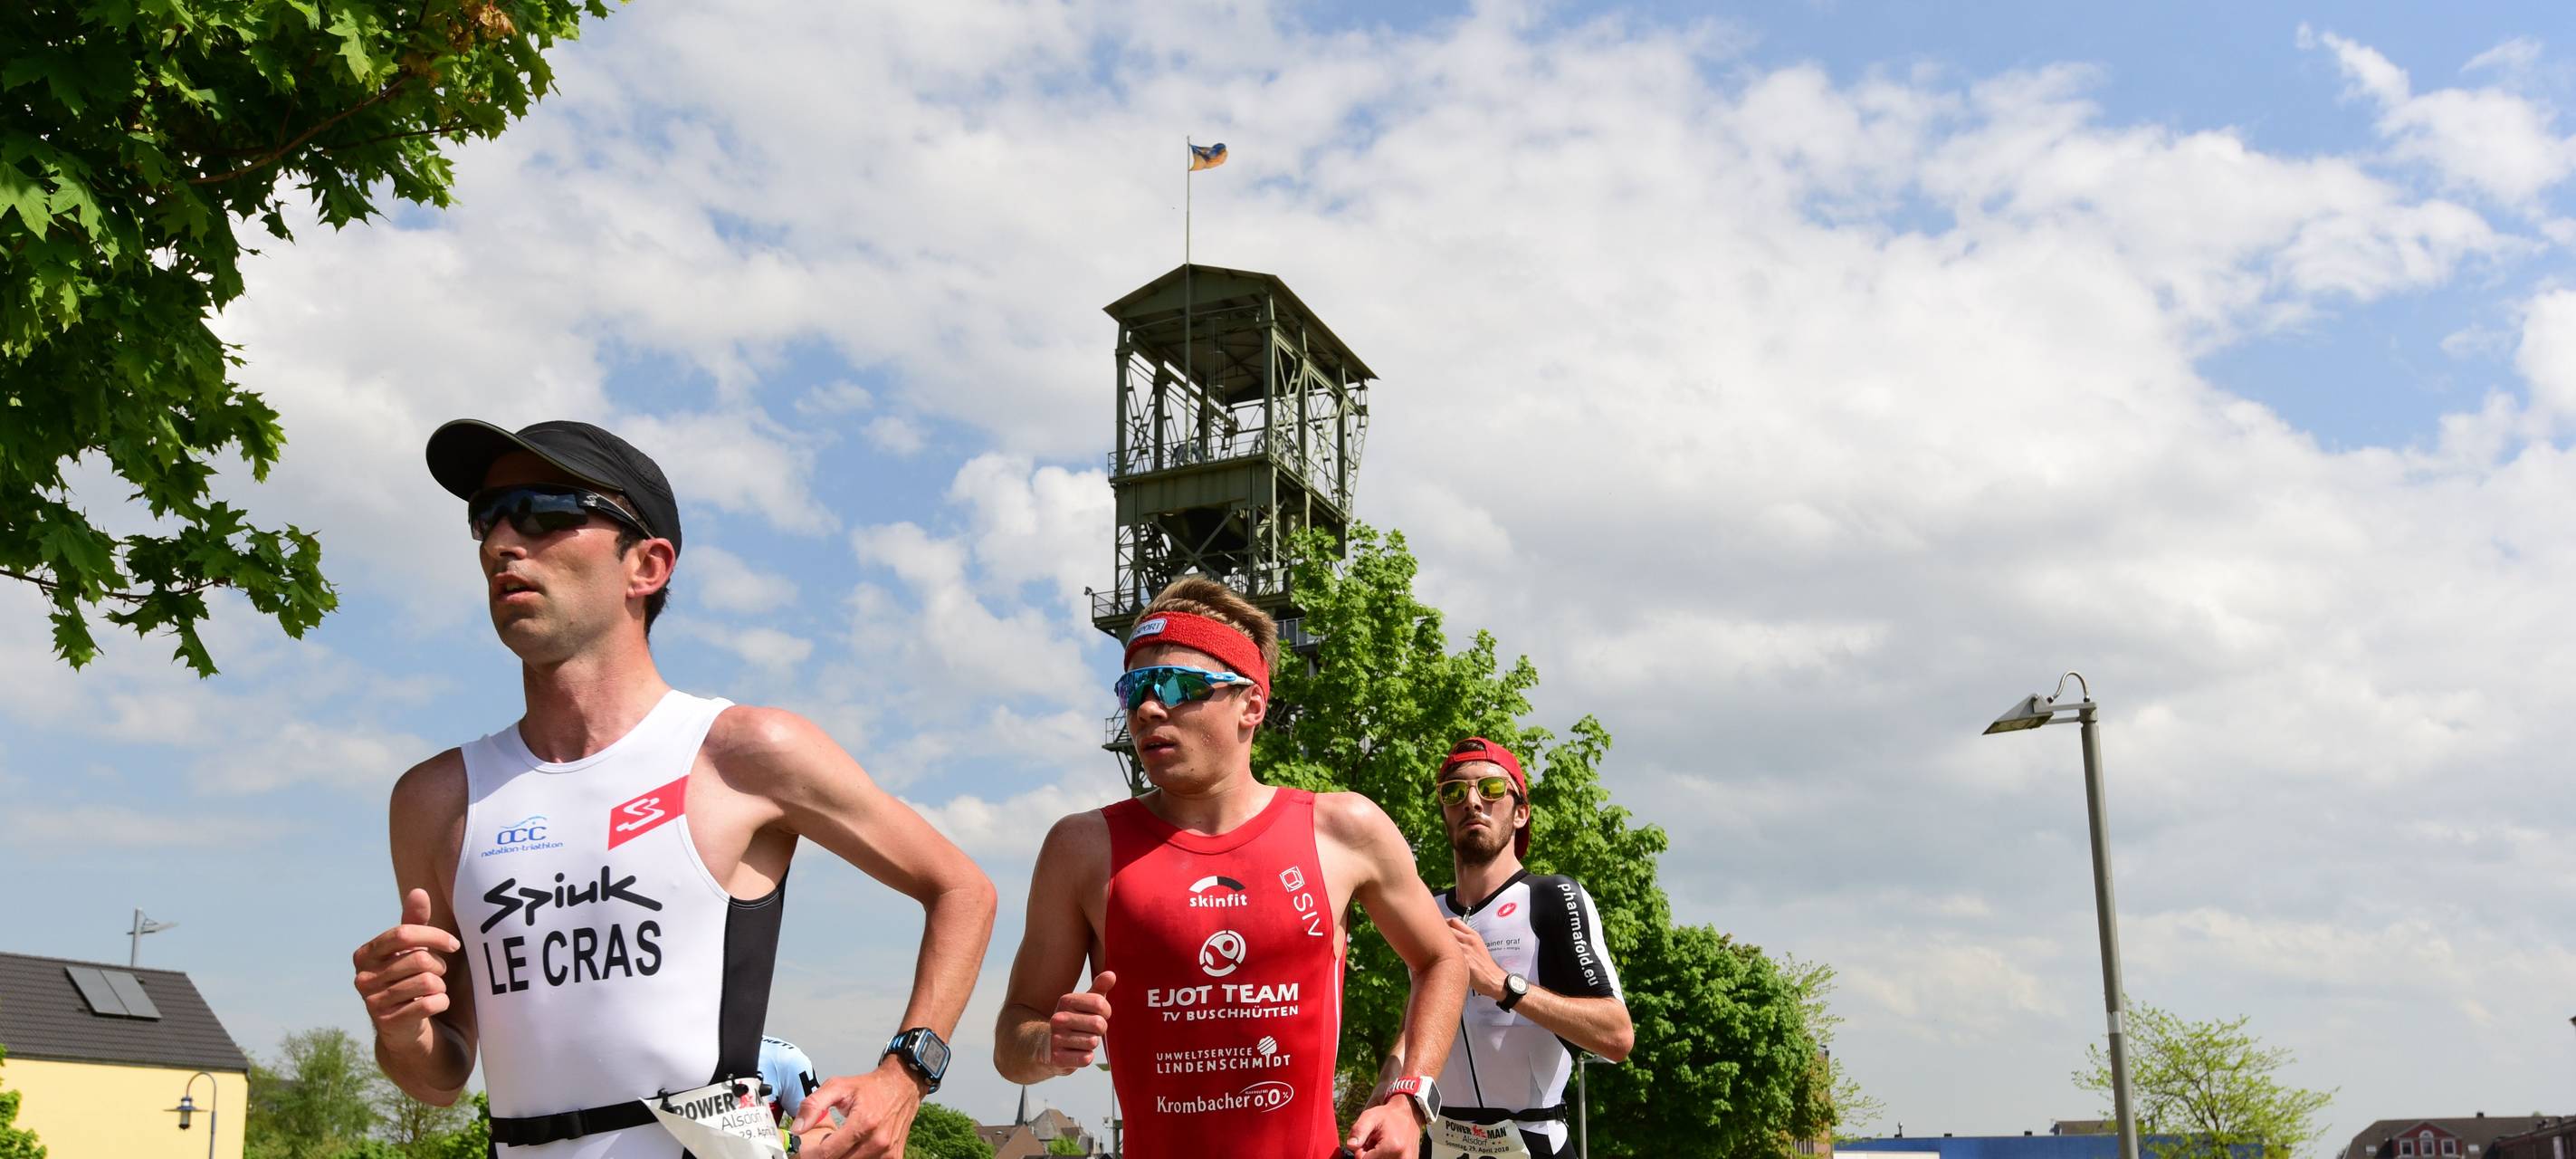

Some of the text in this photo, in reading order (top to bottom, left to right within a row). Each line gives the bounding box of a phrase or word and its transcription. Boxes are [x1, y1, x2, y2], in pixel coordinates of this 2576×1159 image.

[1189, 893, 1247, 907] skinfit
[1293, 893, 1323, 937] SIV
[1506, 937, 1521, 945] graf
[1558, 883, 1598, 987] pharmafold.eu
[483, 920, 662, 995] LE CRAS
[1147, 983, 1299, 1008] EJOT TEAM
[1162, 1005, 1299, 1022] TV BUSCHHÜTTEN
[1156, 1048, 1253, 1061] UMWELTSERVICE
[1157, 1054, 1291, 1074] LINDENSCHMIDT
[1157, 1092, 1250, 1114] Krombacher
[1445, 1121, 1507, 1139] POWER MAN
[1463, 1135, 1487, 1146] Alsdorf
